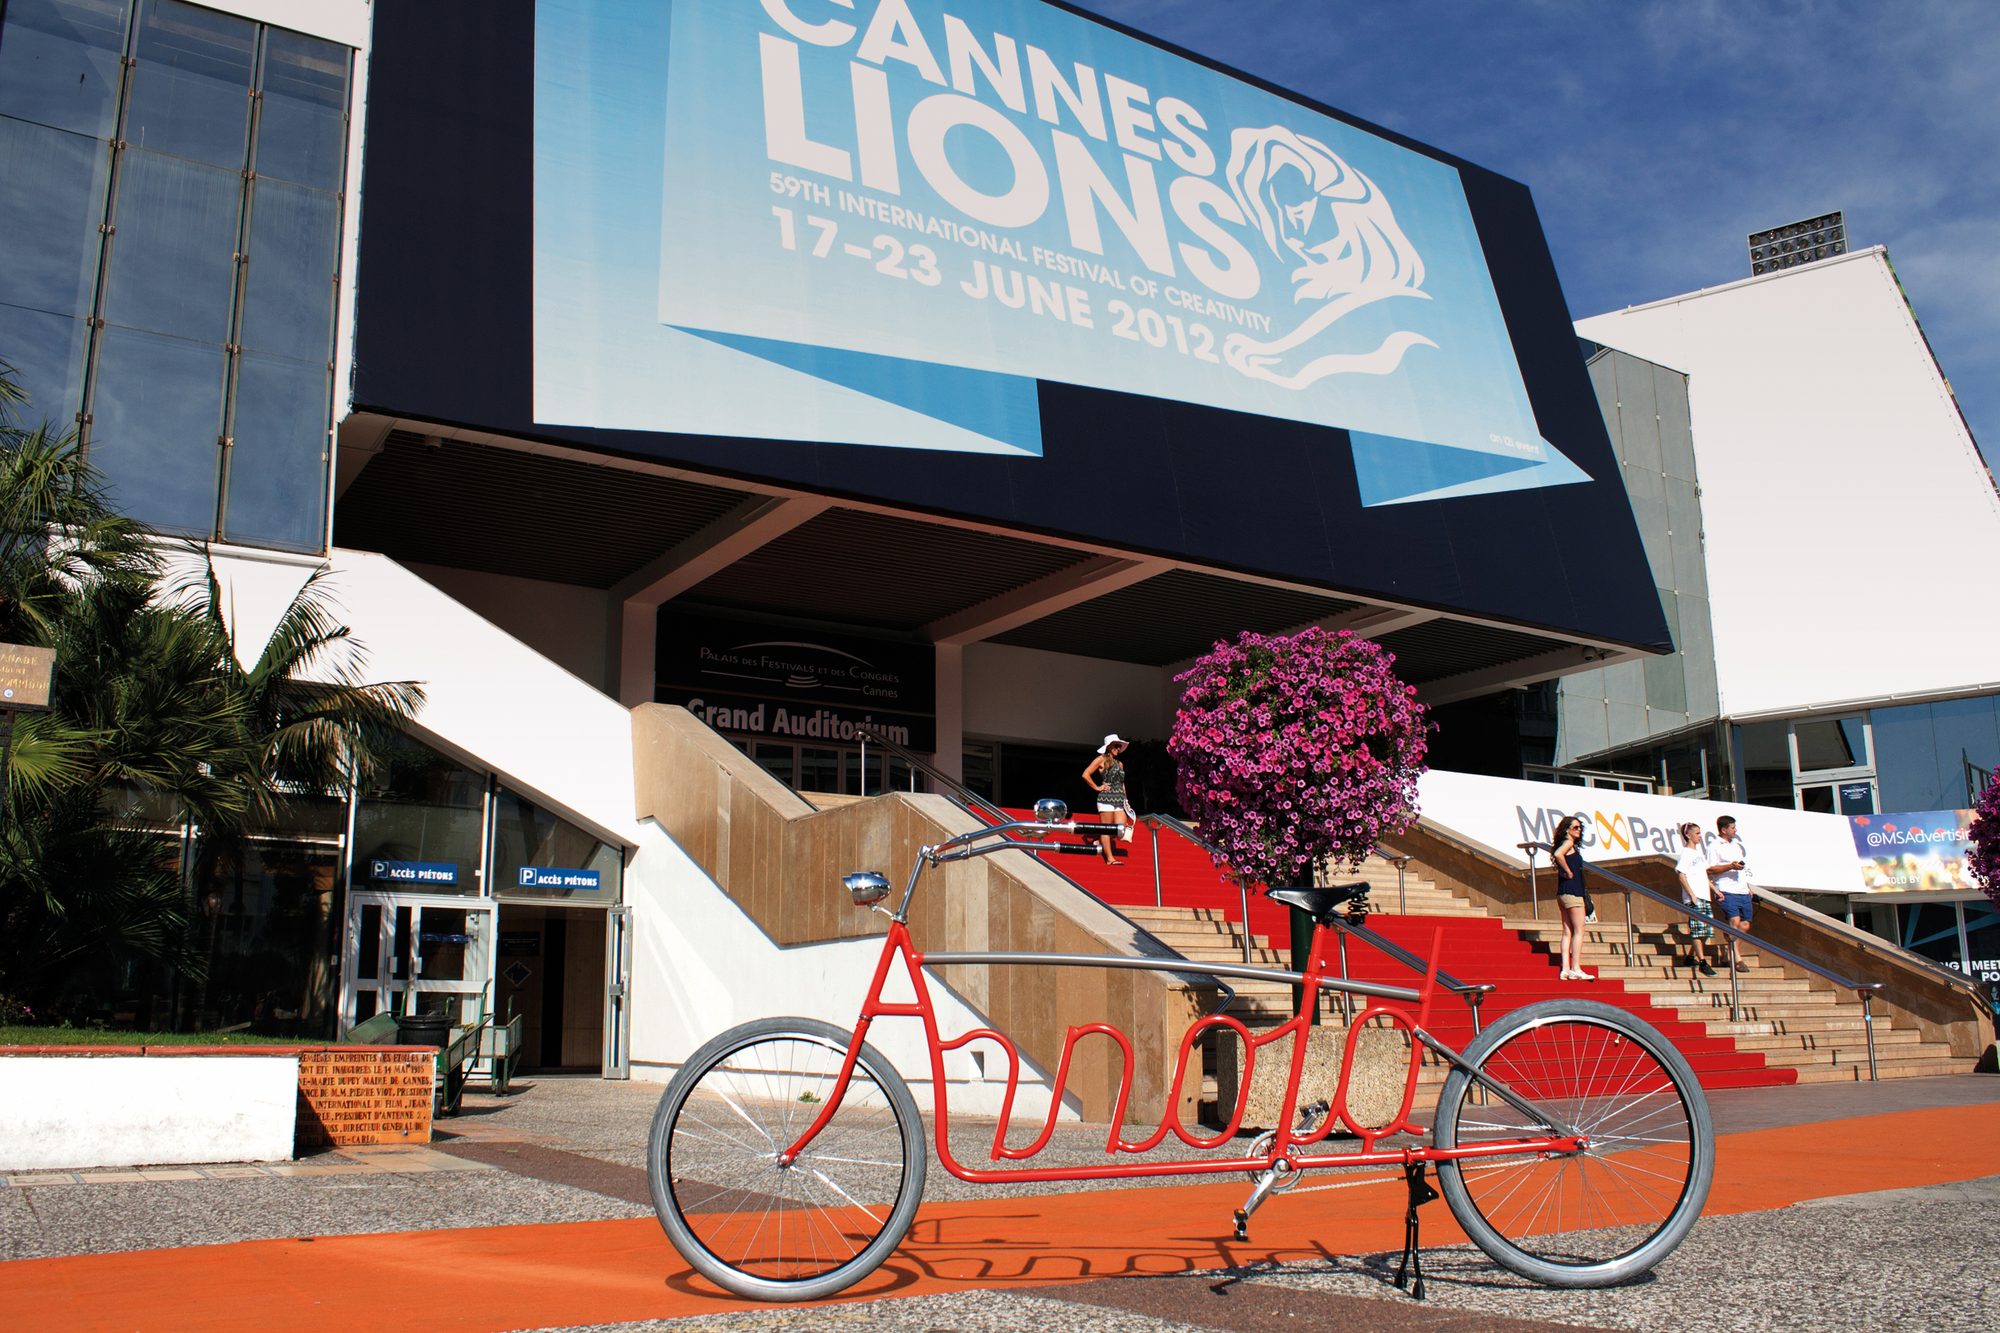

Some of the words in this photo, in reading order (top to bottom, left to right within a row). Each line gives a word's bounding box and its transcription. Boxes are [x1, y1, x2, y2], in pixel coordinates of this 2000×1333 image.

[759, 0, 1217, 177] CANNES
[758, 31, 1261, 299] LIONS
[769, 172, 831, 207] 59TH
[839, 190, 1028, 262] INTERNATIONAL
[1032, 246, 1126, 290] FESTIVAL
[1130, 275, 1158, 299] OF
[1165, 286, 1271, 334] CREATIVITY
[960, 260, 1094, 329] JUNE
[1108, 299, 1220, 364] 2012
[700, 647, 739, 664] PALAIS
[761, 655, 815, 673] FESTIVALS
[862, 685, 898, 698] Cannes
[687, 699, 764, 732] Grand
[772, 707, 909, 746] Auditorium
[390, 868, 415, 879] ACCÈS
[418, 869, 454, 881] PIÉTONS
[538, 874, 562, 885] ACCÈS
[564, 875, 598, 886] PIÉTONS
